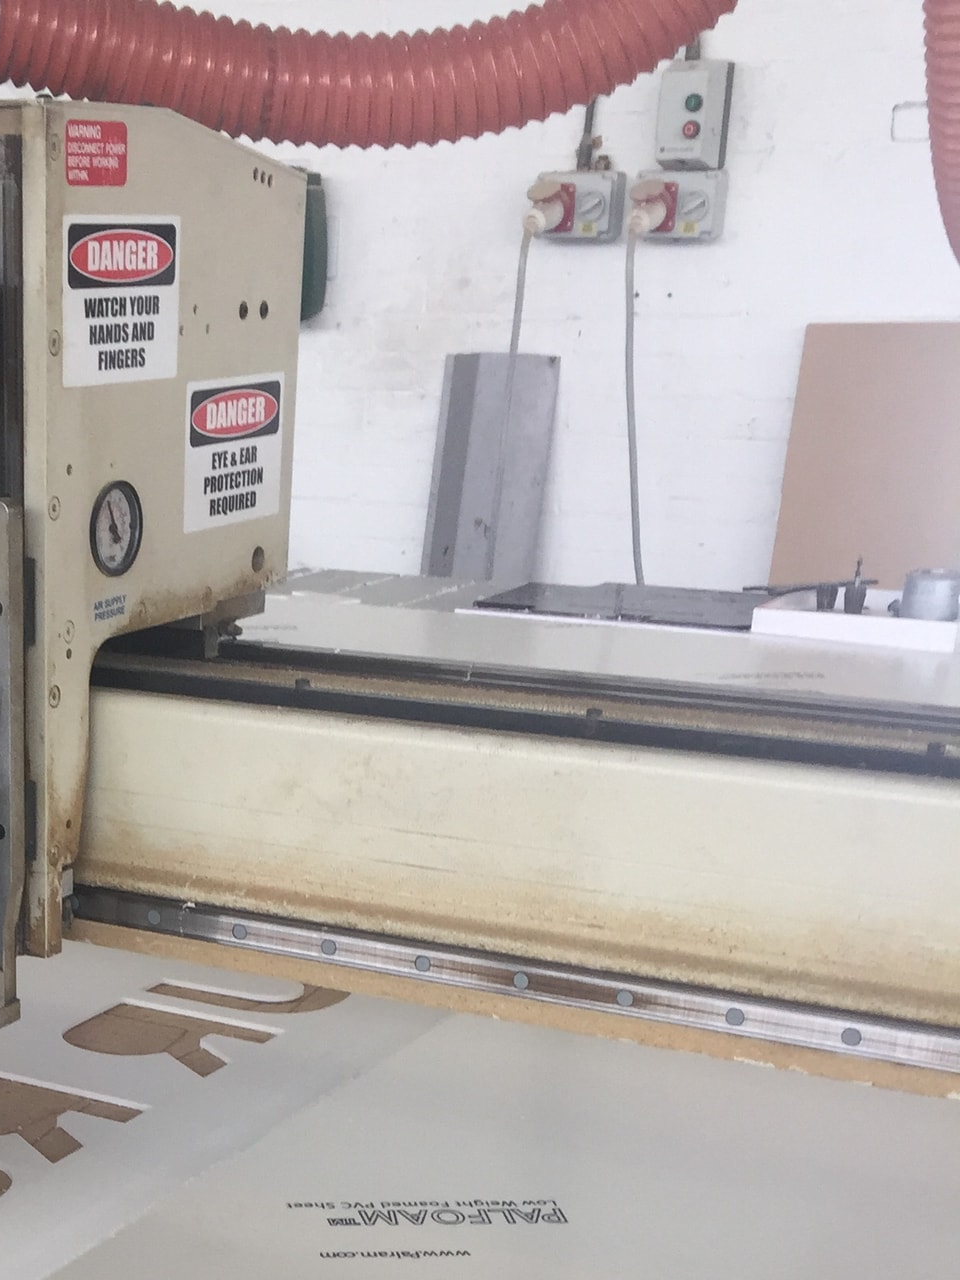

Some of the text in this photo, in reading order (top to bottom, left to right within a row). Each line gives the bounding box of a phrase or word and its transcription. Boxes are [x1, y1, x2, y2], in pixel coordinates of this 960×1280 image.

[67, 123, 102, 140] WARNING
[87, 240, 159, 272] DANGER
[84, 295, 160, 319] WATCH YOUR
[89, 321, 155, 346] HANDS AND
[98, 348, 146, 371] FINGERS
[206, 396, 265, 430] DANGER
[211, 445, 258, 471] EYE & EAR
[203, 466, 264, 495] PROTECTION
[209, 491, 257, 517] REQUIRED
[94, 605, 125, 622] PRESSURE
[104, 594, 126, 609] SUPPLY
